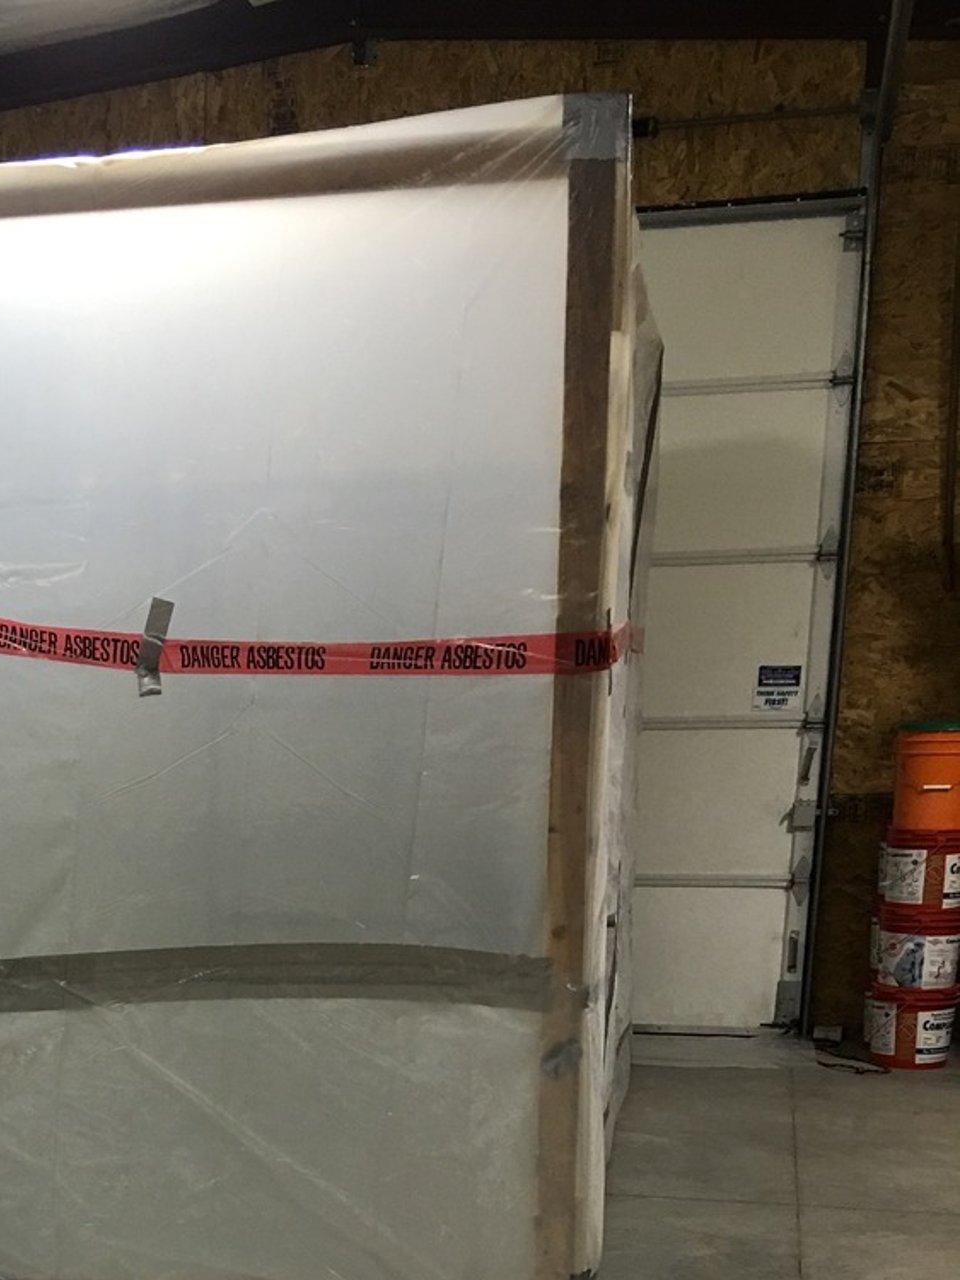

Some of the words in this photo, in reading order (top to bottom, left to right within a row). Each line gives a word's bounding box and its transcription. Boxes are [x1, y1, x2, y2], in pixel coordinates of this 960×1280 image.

[63, 633, 140, 666] ASBESTOS
[179, 645, 241, 669] DANGER
[246, 645, 326, 670] ASBESTOS
[370, 646, 435, 670] DANGER
[440, 642, 527, 670] ASBESTOS
[575, 637, 610, 666] DAN
